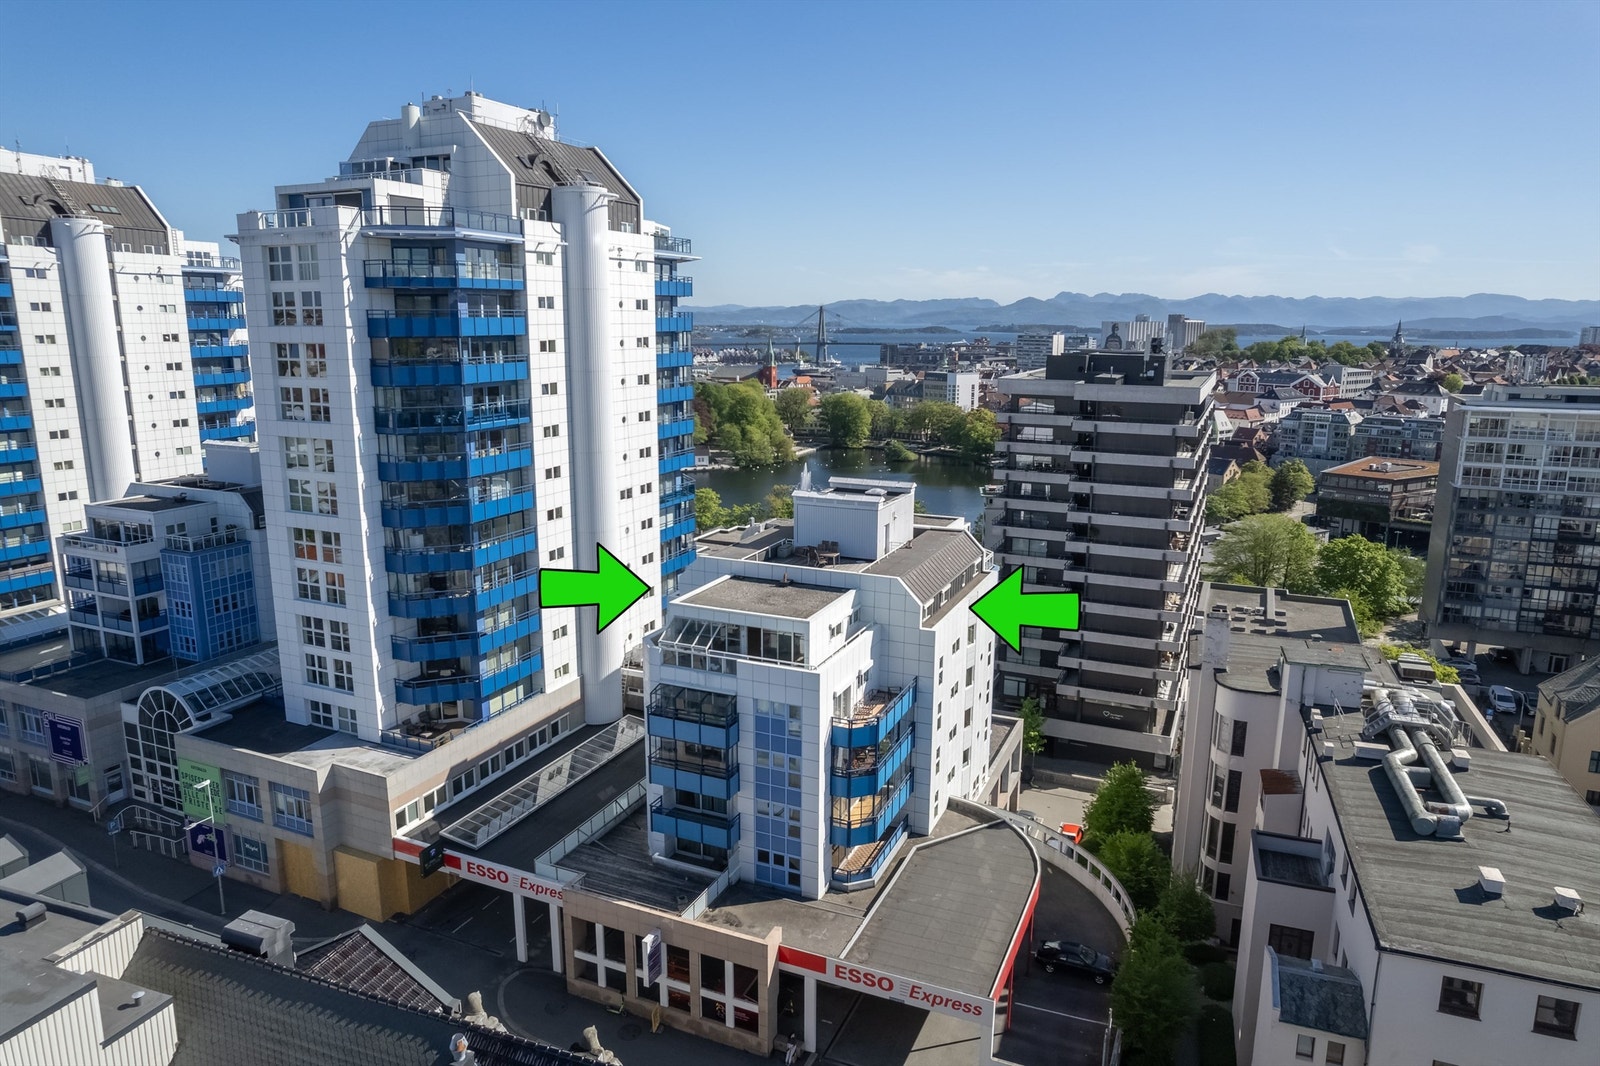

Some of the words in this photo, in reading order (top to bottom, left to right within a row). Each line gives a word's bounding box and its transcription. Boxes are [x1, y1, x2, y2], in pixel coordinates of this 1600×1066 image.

[184, 795, 222, 814] FRISTESE
[466, 861, 509, 884] ESSO
[519, 876, 564, 900] Expres
[834, 964, 894, 992] ESSO
[908, 984, 983, 1016] Express
